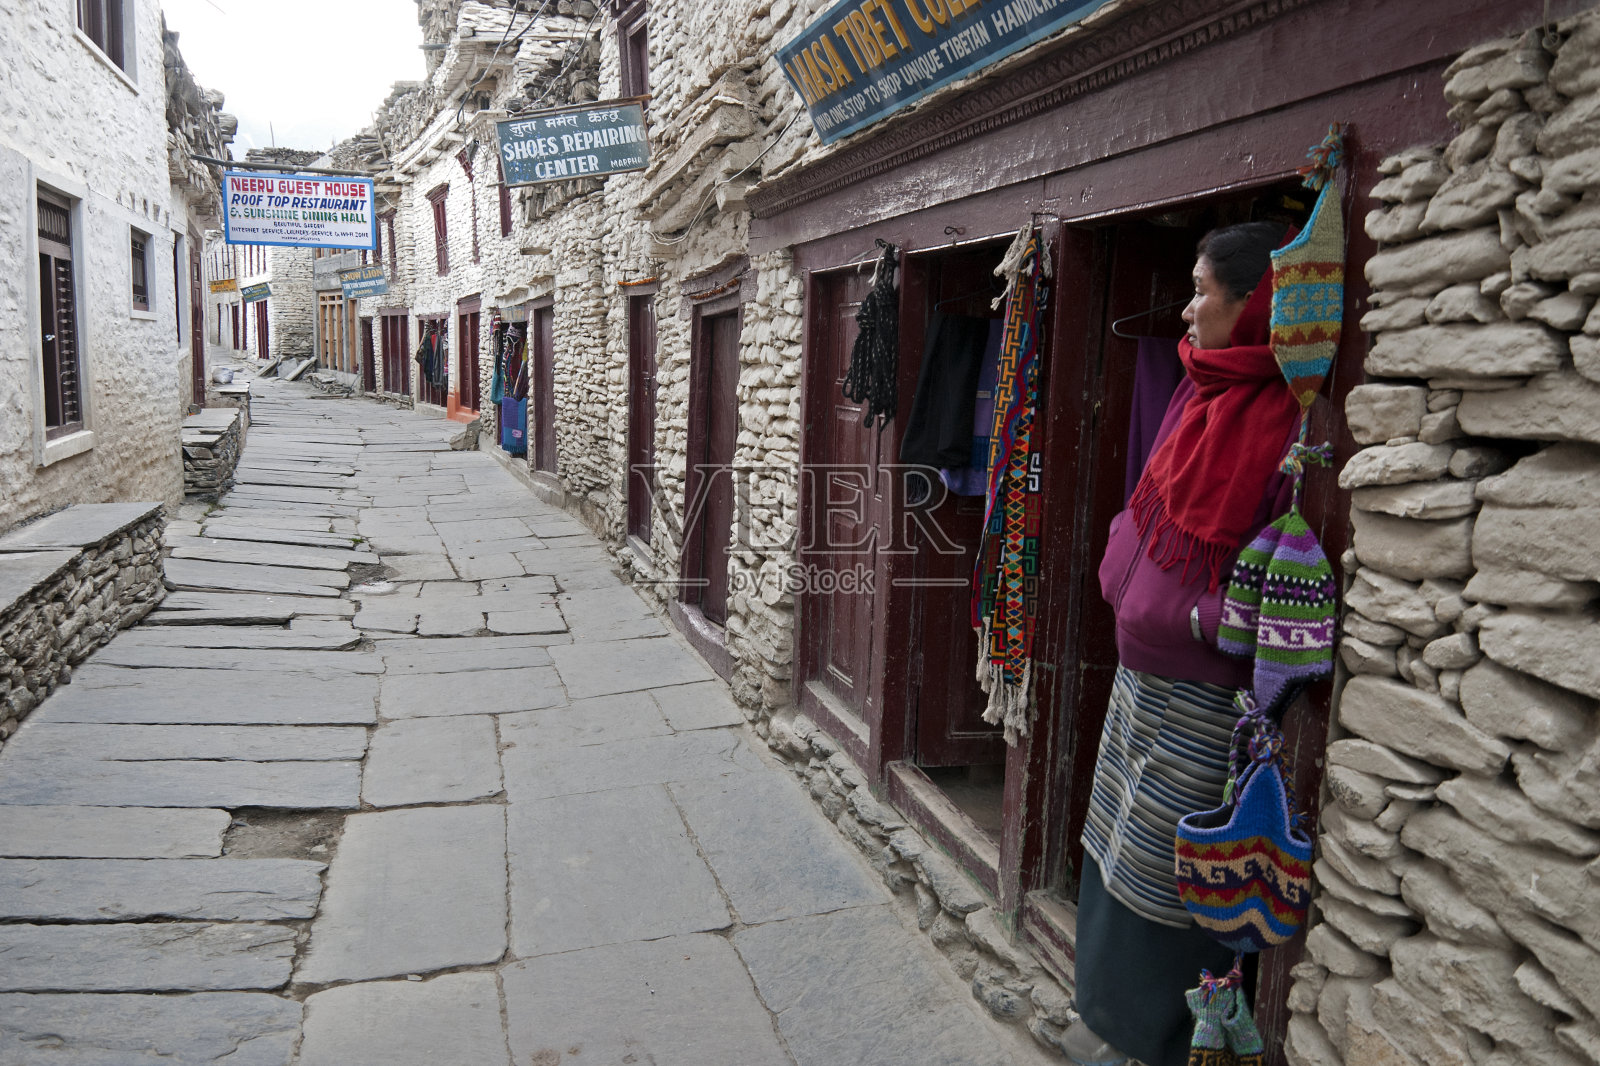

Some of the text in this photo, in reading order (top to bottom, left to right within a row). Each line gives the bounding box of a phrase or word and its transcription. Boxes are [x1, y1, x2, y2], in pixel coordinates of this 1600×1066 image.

[785, 34, 854, 106] LHASA
[833, 0, 909, 75] TIBET
[815, 111, 835, 132] YOUR
[830, 104, 850, 125] ONE
[845, 93, 867, 119] STOP
[863, 84, 881, 106] TO
[877, 72, 902, 99] SHOP
[899, 48, 945, 86] UNIQUE
[940, 20, 992, 64] TIBETAN
[503, 124, 646, 162] SHOES REPAIRING
[535, 154, 643, 179] CENTER MARPHA
[231, 178, 366, 197] NEERU GUEST HOUSE
[231, 193, 367, 211] ROOF TOP RESTAURANT
[243, 207, 299, 220] SUNSHINE
[302, 210, 338, 222] DINING
[340, 212, 367, 223] HALL
[362, 269, 384, 280] LION
